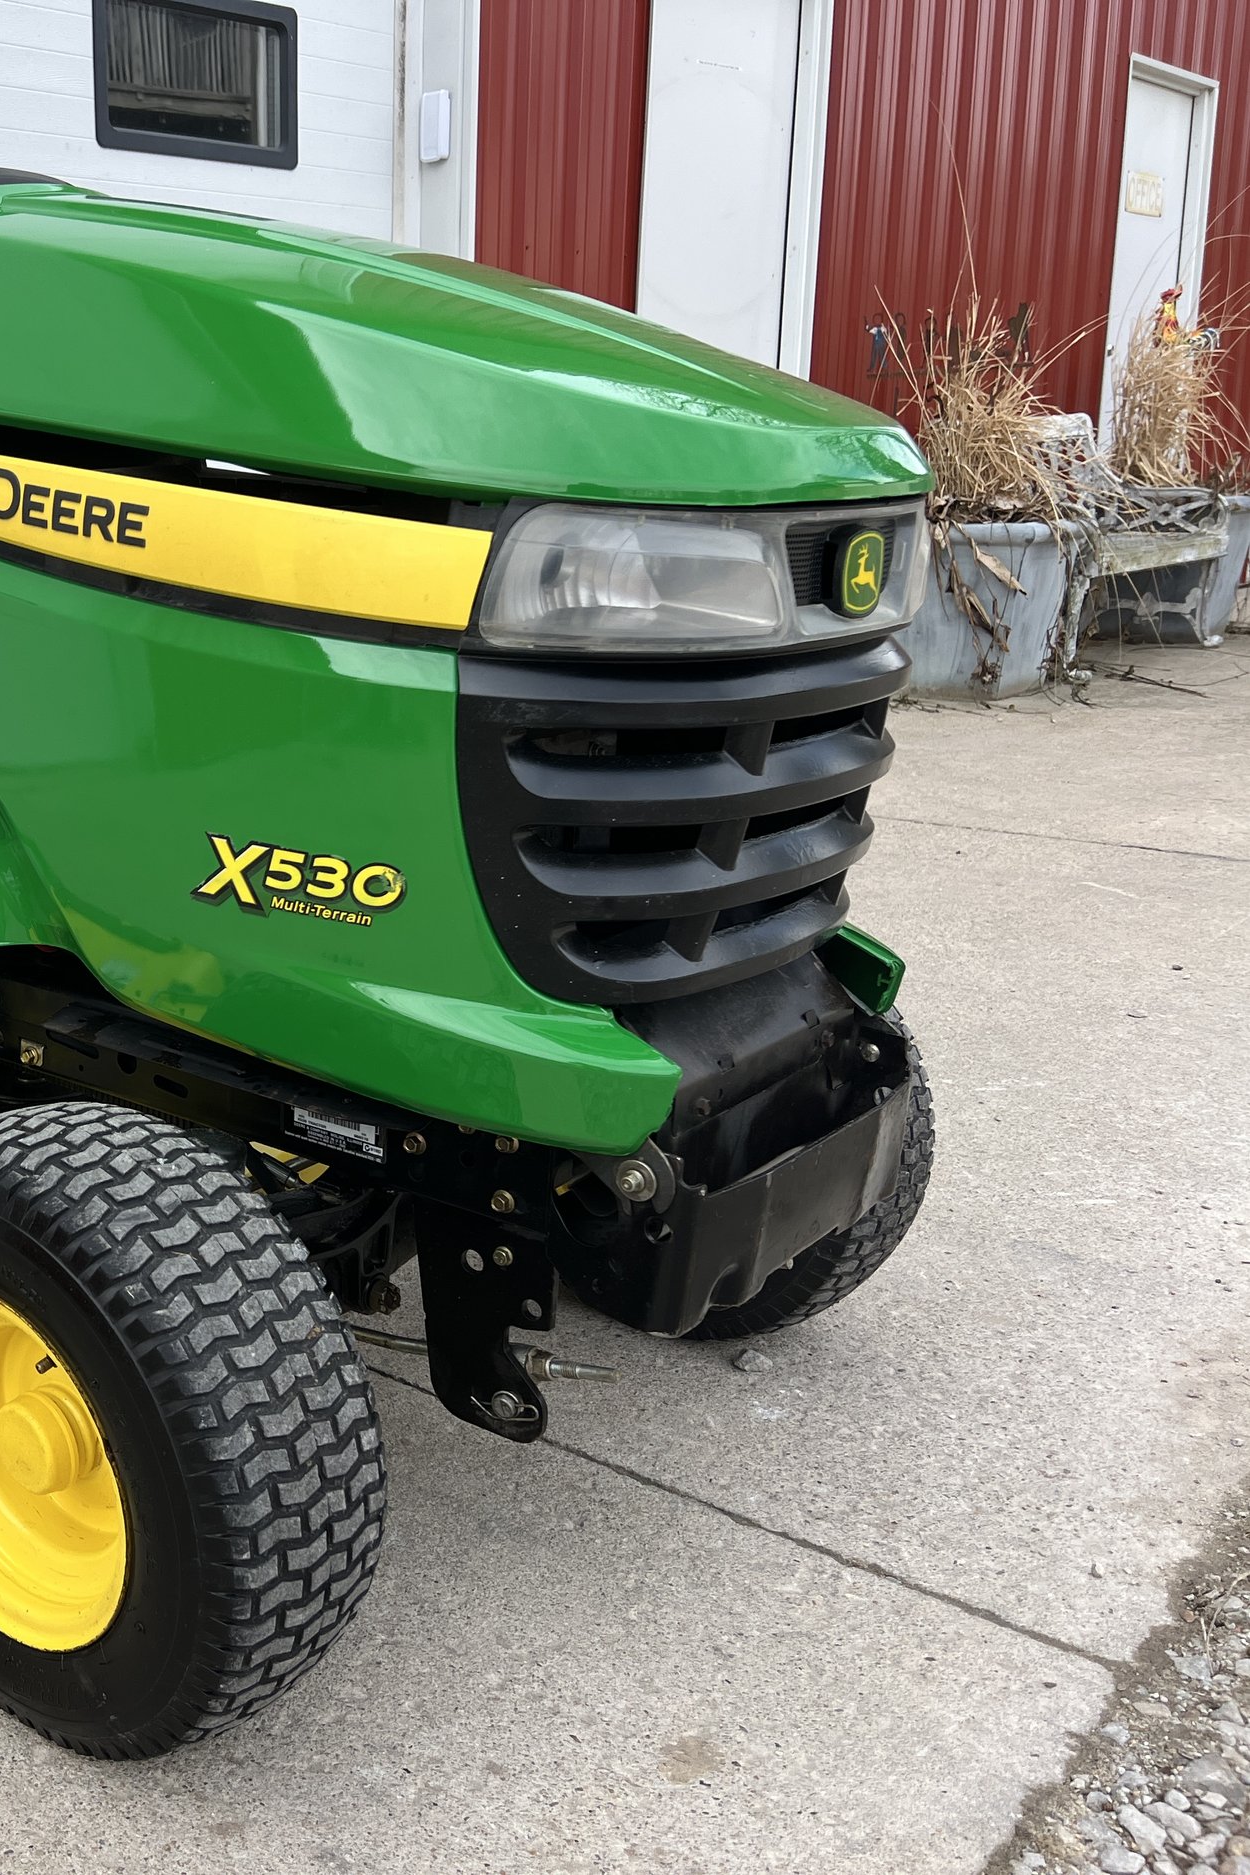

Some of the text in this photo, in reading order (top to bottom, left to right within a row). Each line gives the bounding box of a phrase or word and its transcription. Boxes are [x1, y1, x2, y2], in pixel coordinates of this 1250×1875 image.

[1128, 177, 1162, 210] OFFICE
[192, 831, 406, 914] X530
[270, 896, 373, 926] Multi-Terrain
